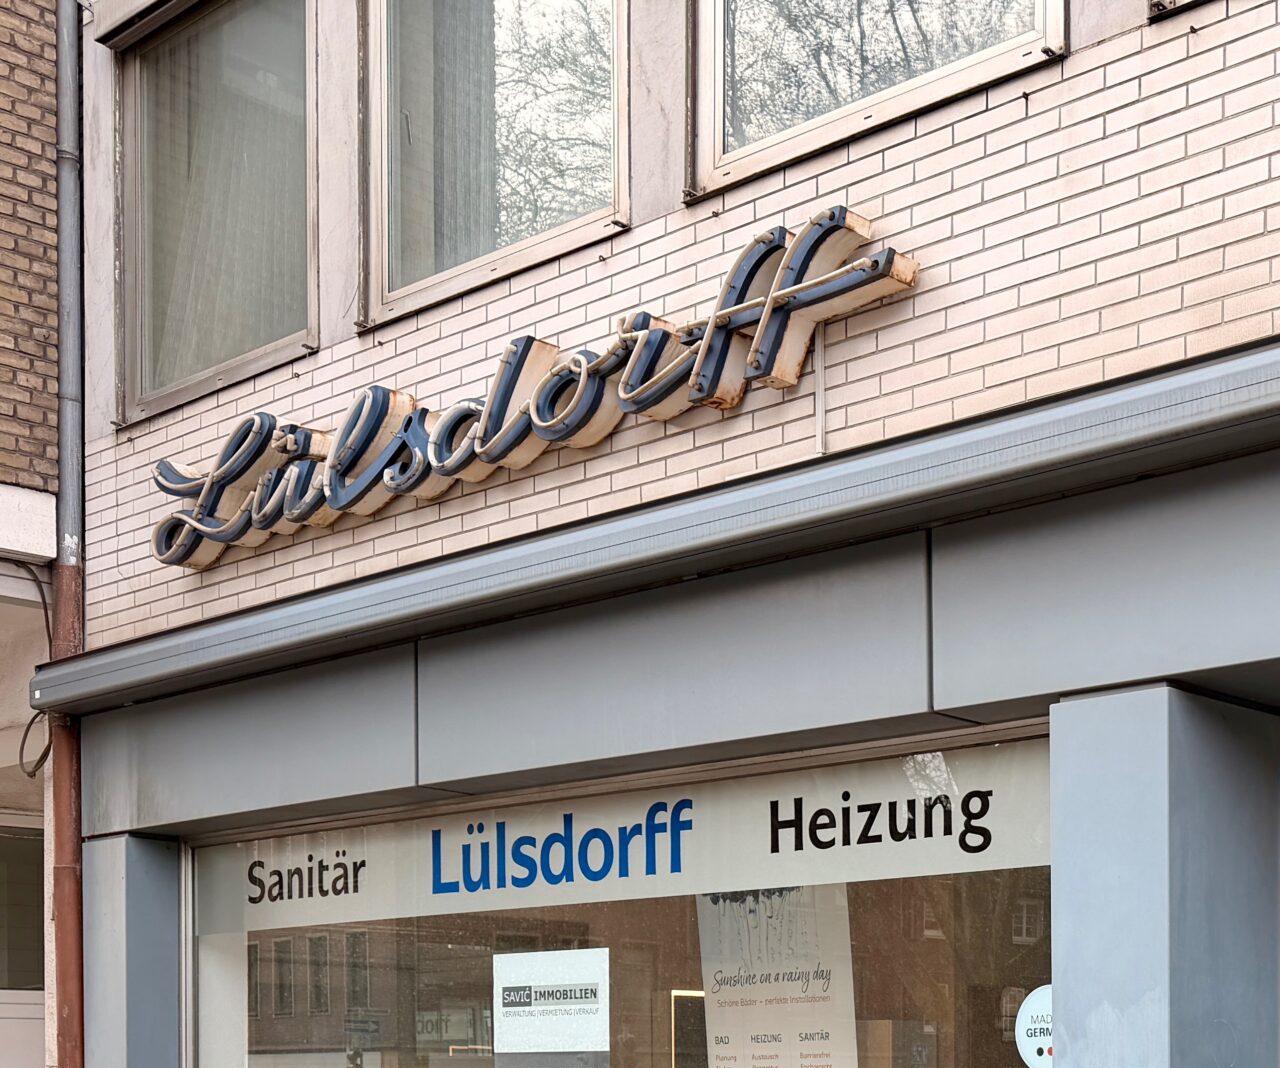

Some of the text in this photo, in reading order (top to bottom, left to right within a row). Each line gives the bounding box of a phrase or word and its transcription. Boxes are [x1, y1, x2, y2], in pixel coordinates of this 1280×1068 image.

[150, 204, 916, 567] Lülsdorff
[248, 790, 993, 904] Sanitär Lülsdorff Heizung
[711, 961, 831, 994] Sunshine on a rainy day
[503, 987, 597, 1003] SAVIĆ IMMOBILIEN
[714, 1029, 830, 1045] BAD HEIZUNG SANITÄR
